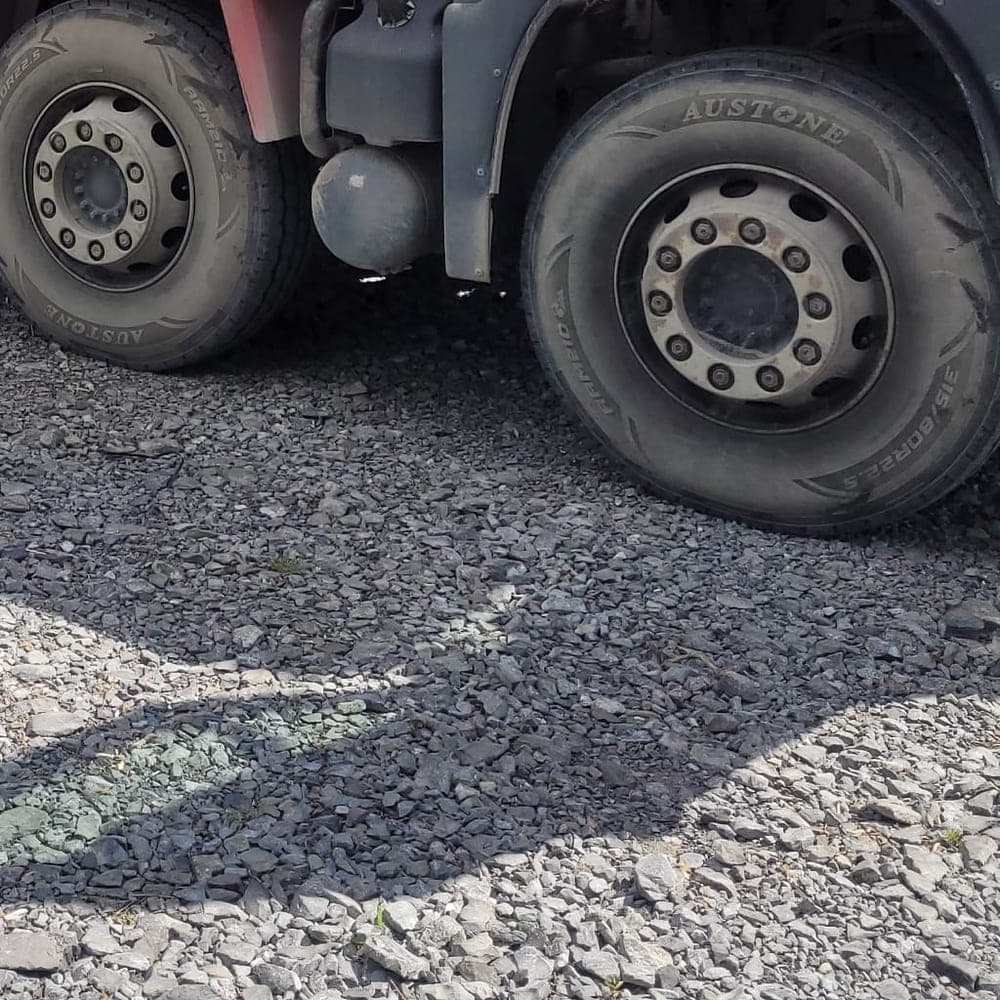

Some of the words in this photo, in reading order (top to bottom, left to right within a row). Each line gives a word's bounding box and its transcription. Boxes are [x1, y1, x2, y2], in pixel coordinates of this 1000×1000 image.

[682, 97, 850, 145] AUSTONE
[43, 303, 145, 345] AUSTONE
[843, 364, 960, 491] 315/80R22.5
